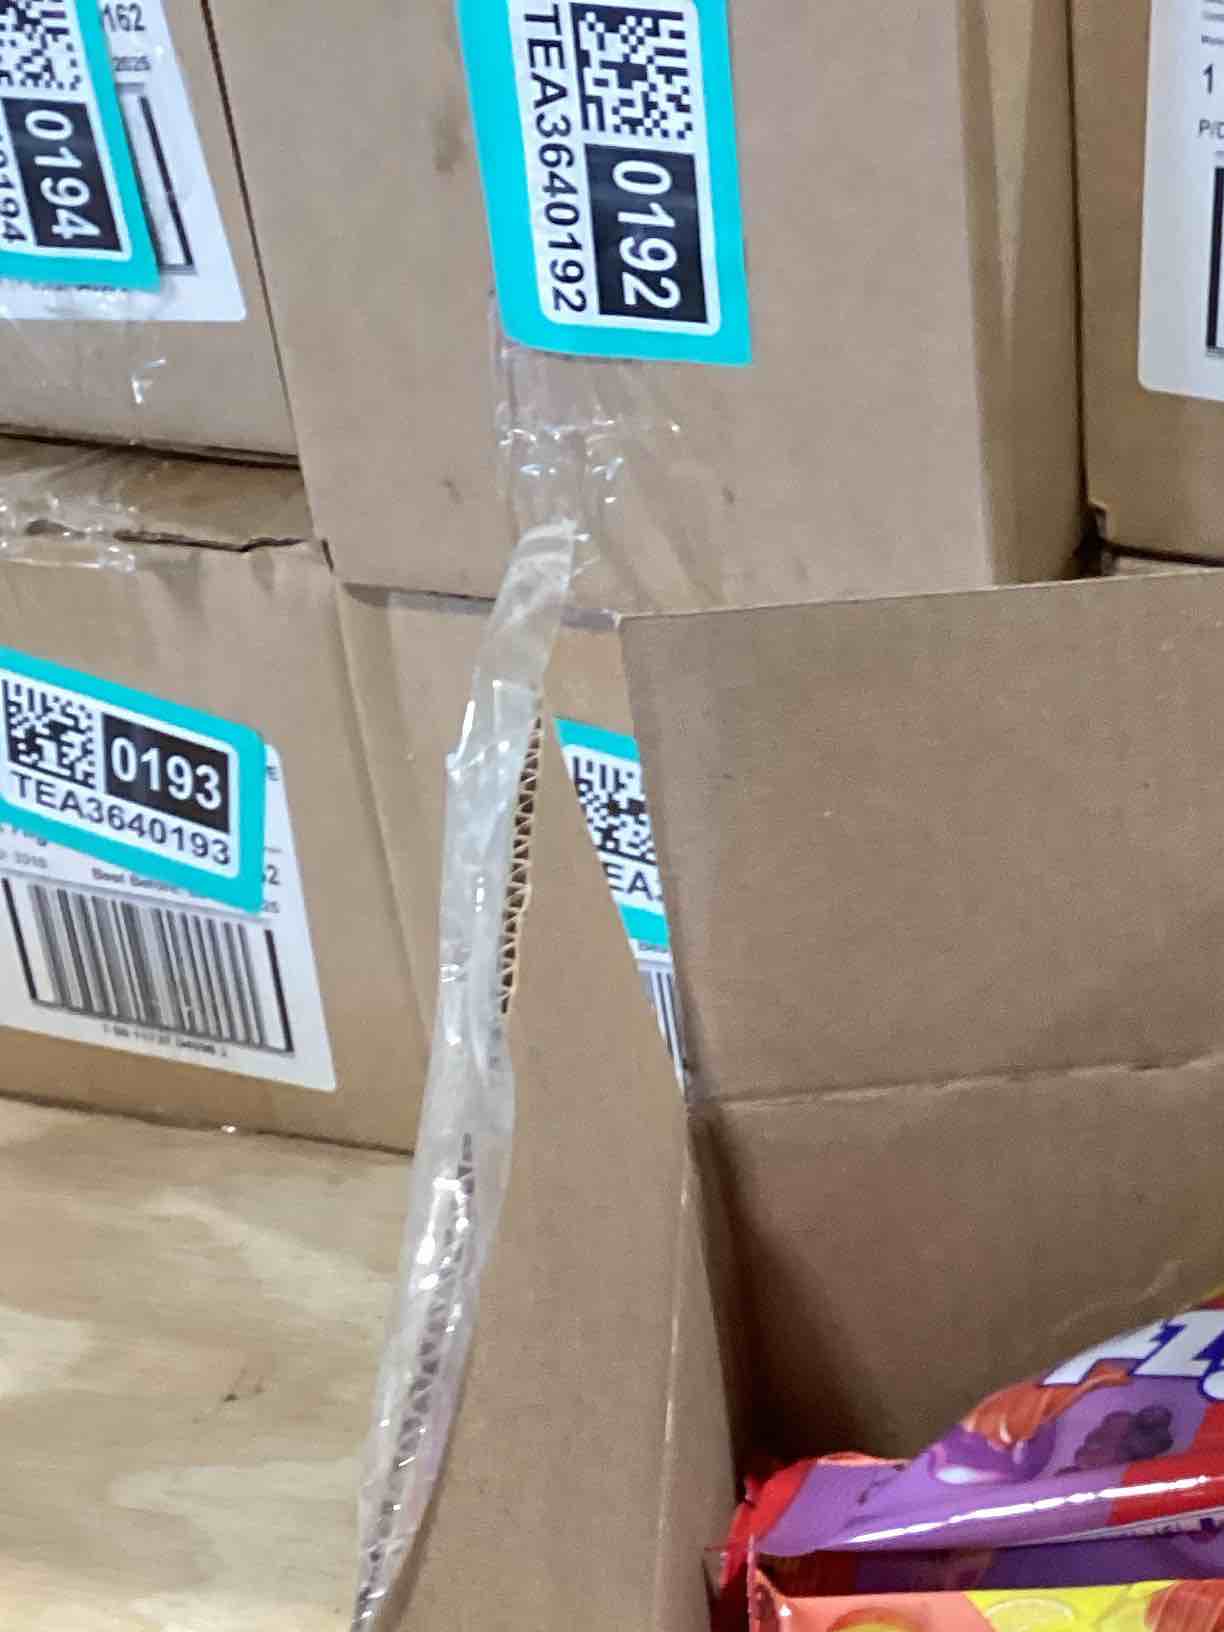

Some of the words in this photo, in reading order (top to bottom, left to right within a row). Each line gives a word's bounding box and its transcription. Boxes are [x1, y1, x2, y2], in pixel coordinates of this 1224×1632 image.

[25, 109, 101, 240] 0194
[524, 3, 587, 313] TEA3640192
[612, 159, 681, 309] 0192
[10, 770, 231, 866] TEA3640193
[110, 736, 223, 811] 0193
